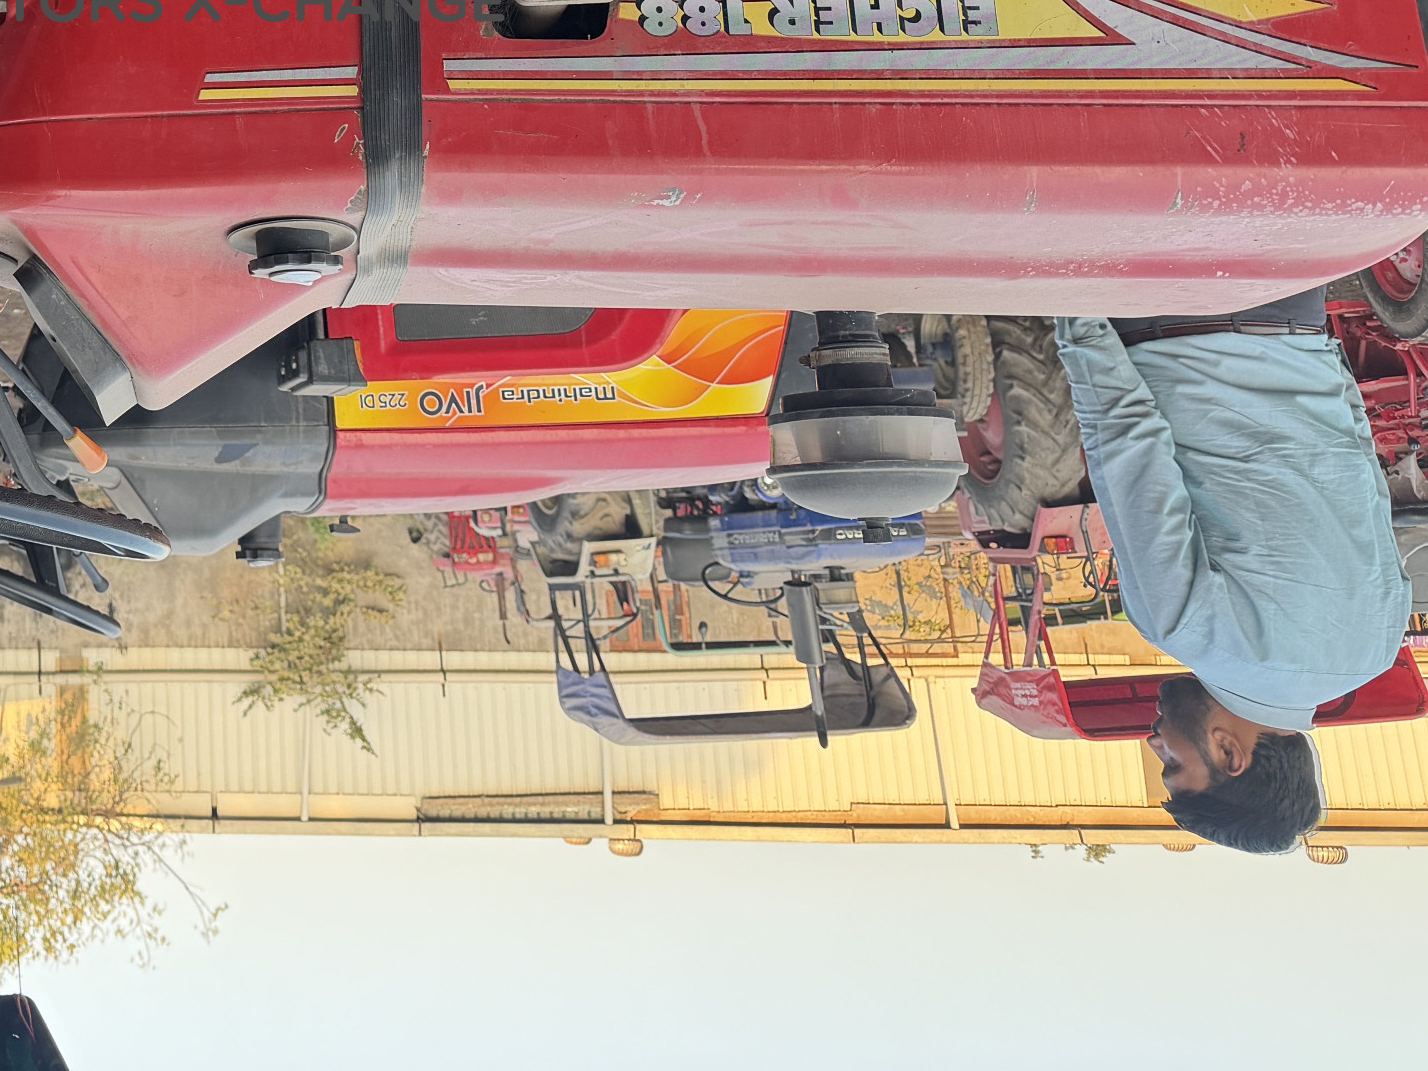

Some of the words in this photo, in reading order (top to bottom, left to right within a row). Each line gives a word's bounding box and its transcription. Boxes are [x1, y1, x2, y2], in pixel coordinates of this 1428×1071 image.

[359, 393, 375, 410] DI
[377, 392, 408, 409] 225
[418, 382, 485, 419] JIVO
[501, 385, 615, 405] Mahindra
[835, 526, 907, 540] FARAC
